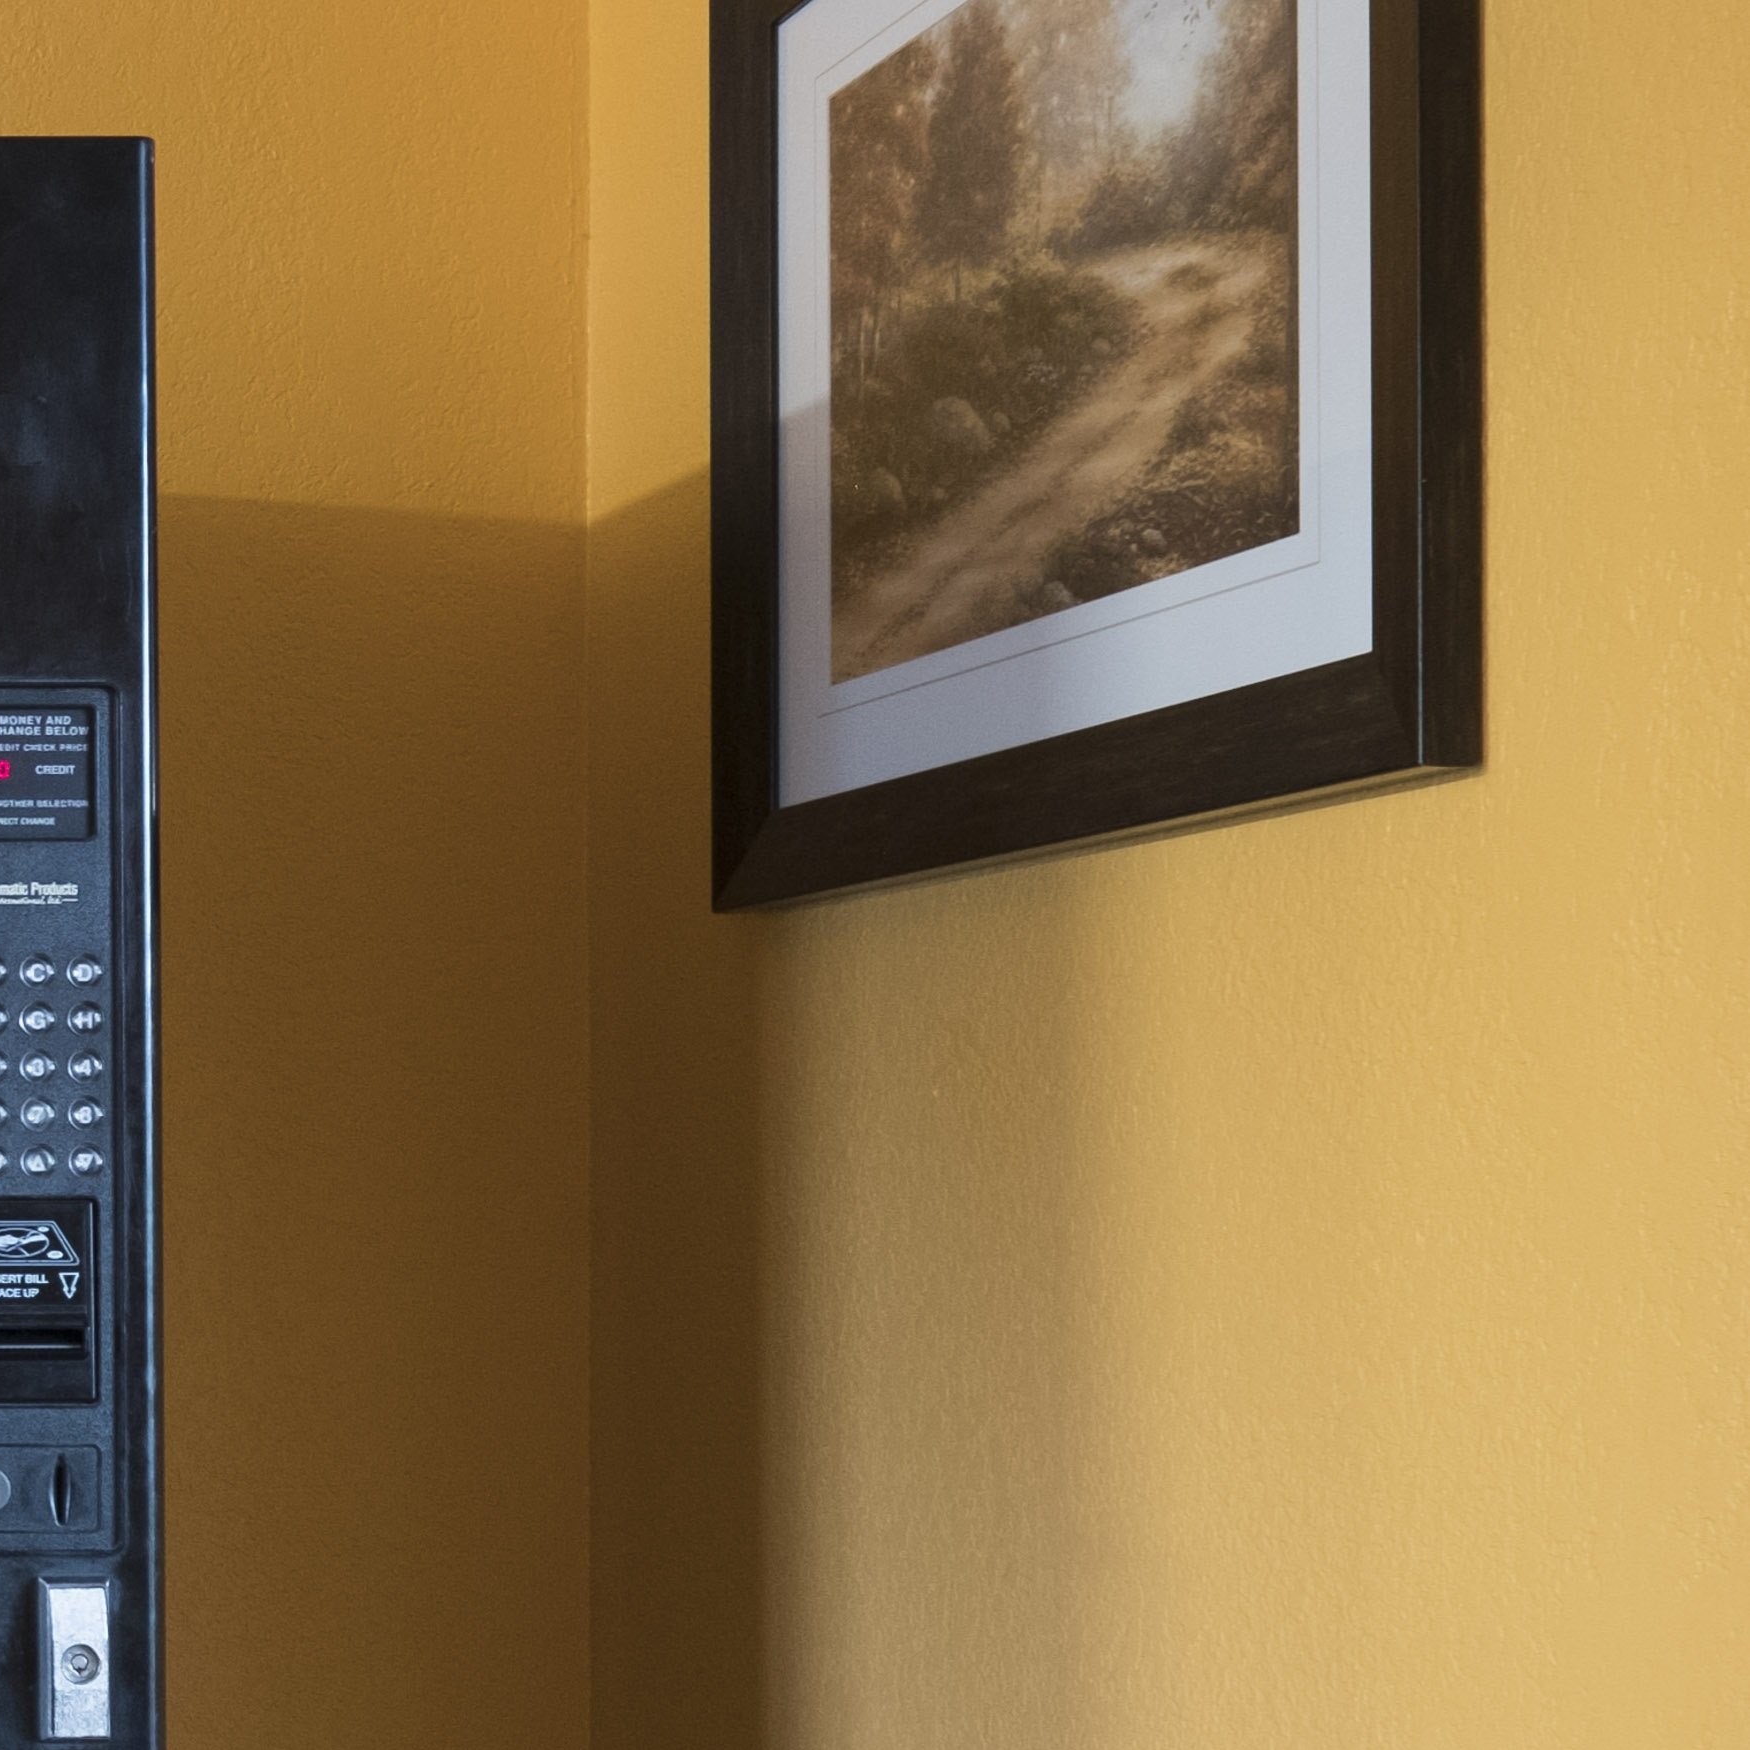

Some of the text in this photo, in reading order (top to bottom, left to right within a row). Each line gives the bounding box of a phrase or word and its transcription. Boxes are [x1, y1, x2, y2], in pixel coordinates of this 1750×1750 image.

[0, 716, 42, 725] MONEY
[45, 716, 71, 725] AND
[45, 726, 88, 736] BELOW
[35, 765, 76, 775] CREDIT
[20, 818, 55, 826] CHANGE
[31, 882, 78, 896] Products
[25, 1274, 49, 1284] BILL
[22, 1288, 39, 1298] UP
